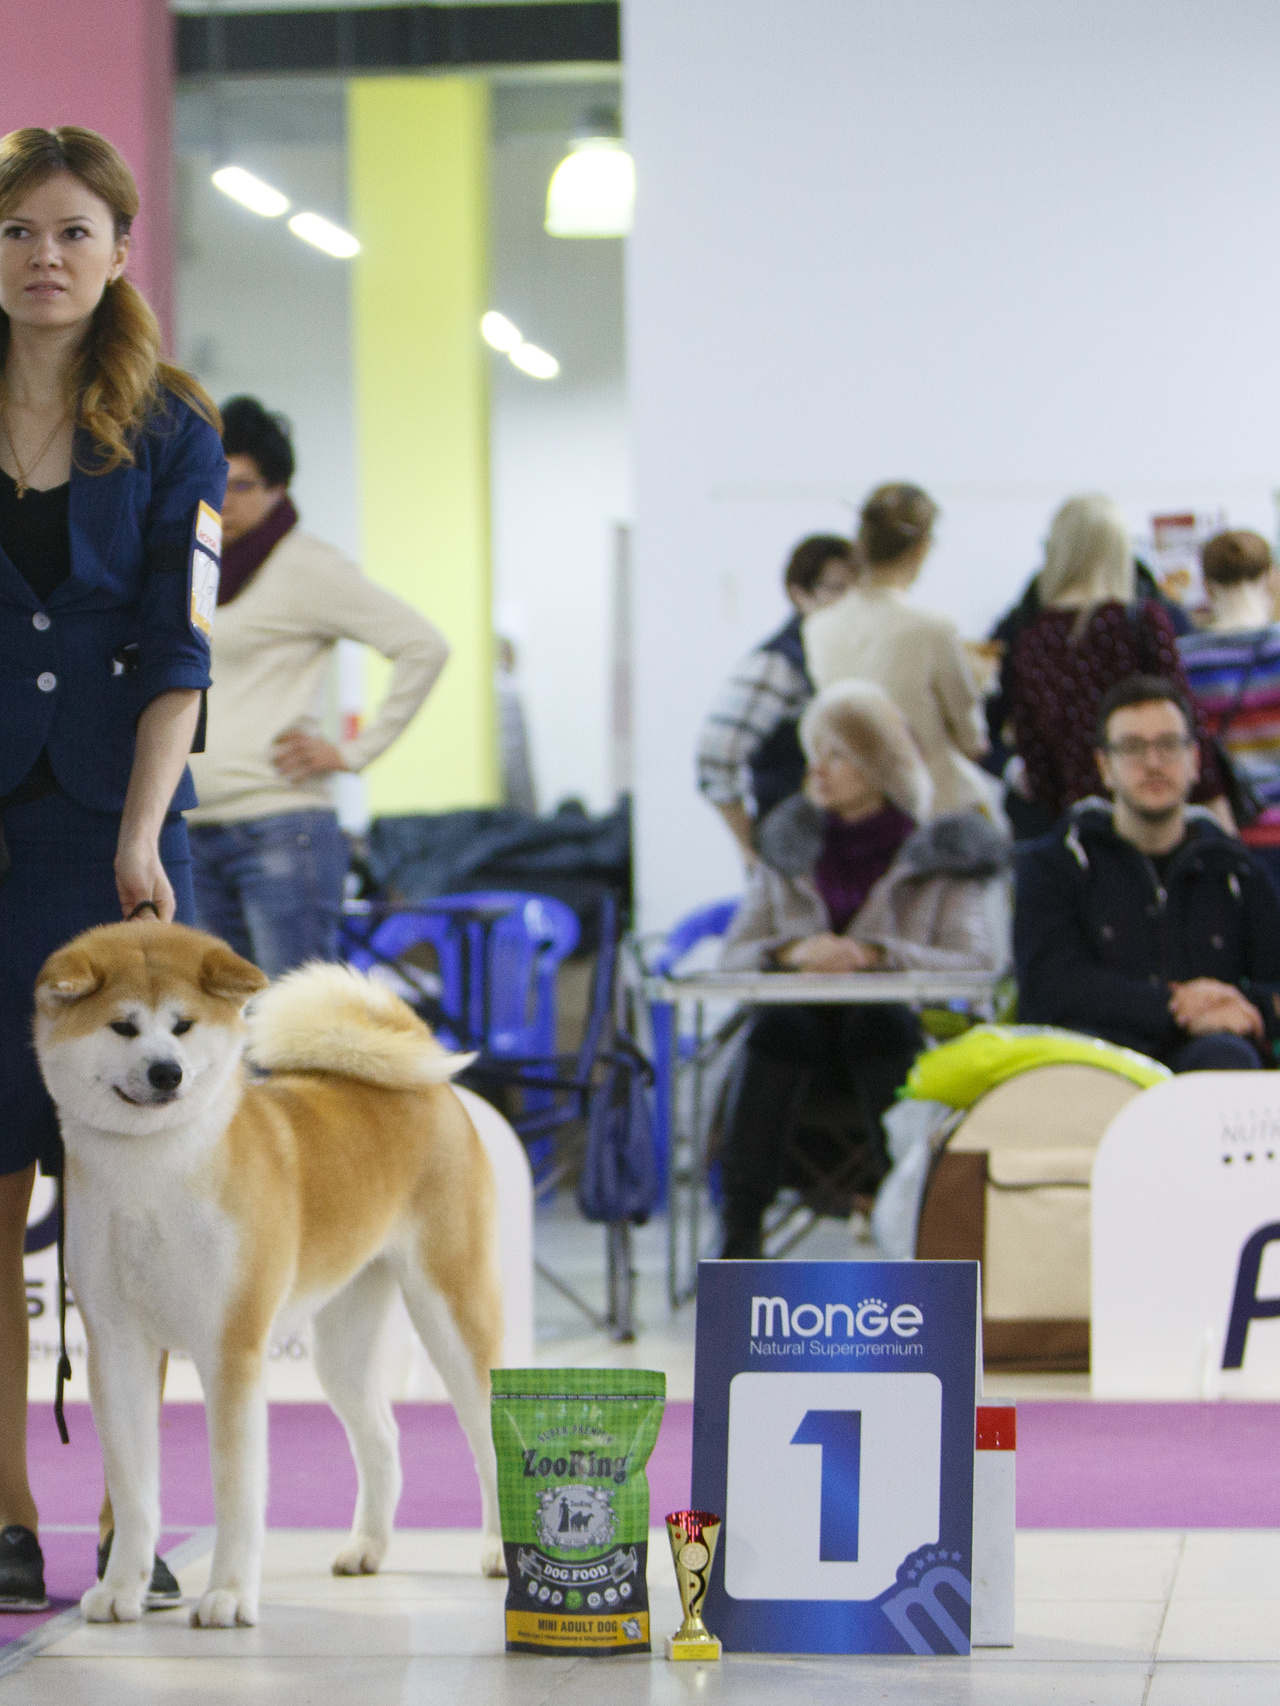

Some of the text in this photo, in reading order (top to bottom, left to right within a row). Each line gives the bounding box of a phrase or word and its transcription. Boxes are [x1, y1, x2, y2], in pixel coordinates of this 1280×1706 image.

[750, 1340, 923, 1358] Natural Superpremium
[538, 1425, 569, 1443] SUPER
[522, 1449, 629, 1484] ZooKing
[789, 1409, 862, 1562] 1
[543, 1563, 609, 1582] DOG FOOD
[537, 1618, 618, 1633] MINI ADULT DOG
